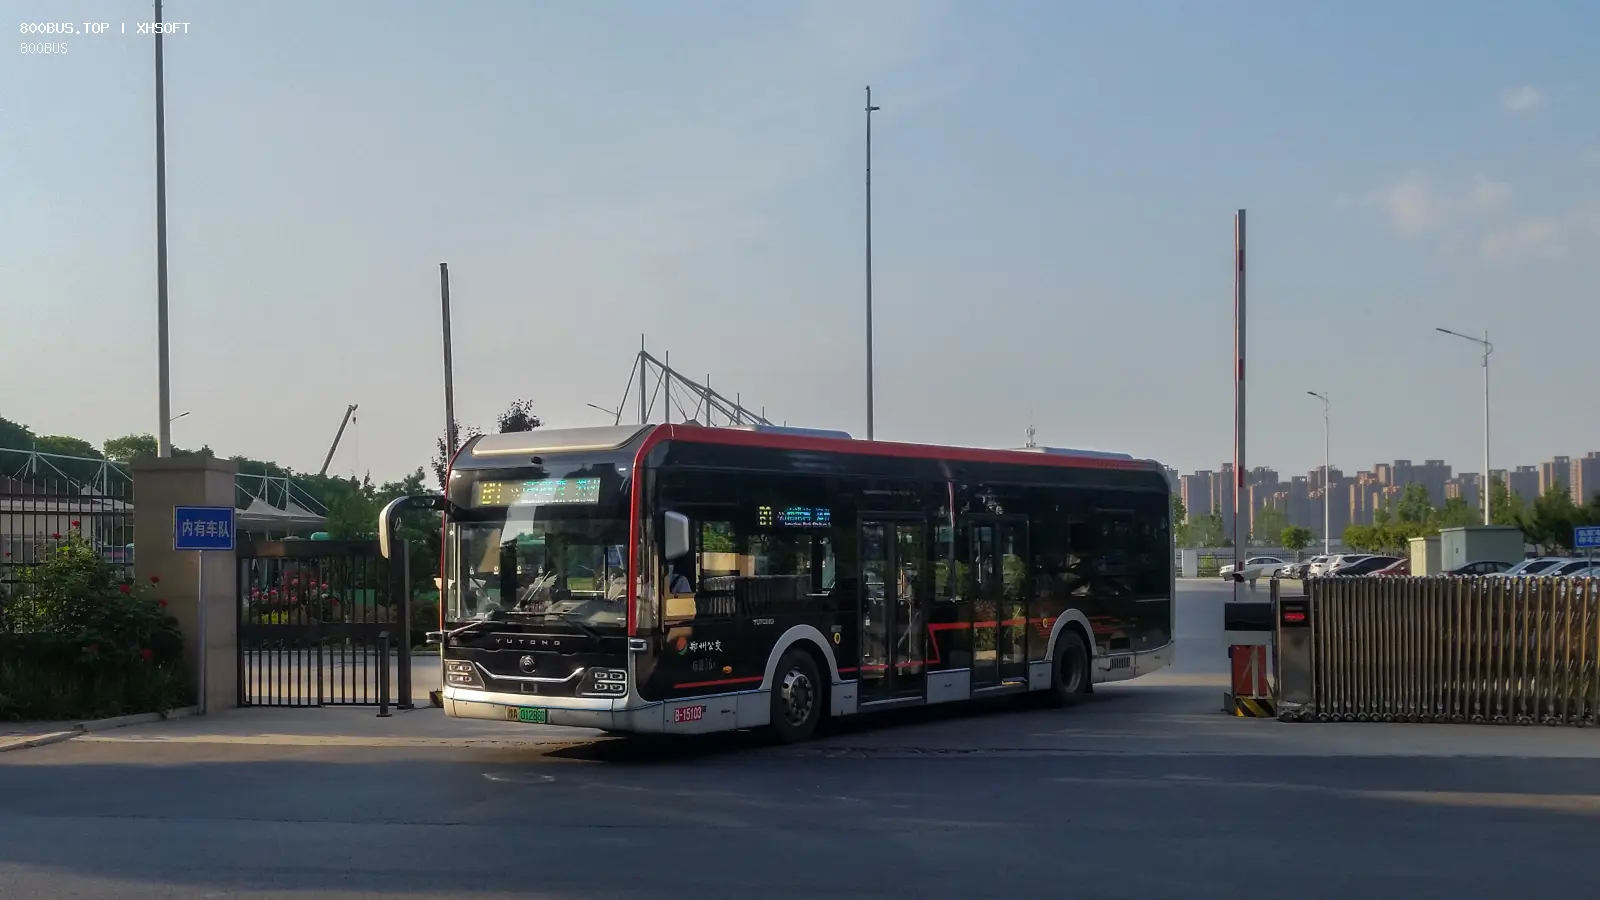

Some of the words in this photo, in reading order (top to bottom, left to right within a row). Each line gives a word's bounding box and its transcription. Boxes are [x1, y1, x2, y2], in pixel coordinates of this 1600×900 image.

[182, 519, 230, 538] 内有车队
[495, 638, 561, 646] YUTONG
[689, 639, 723, 653] 郑州公交
[674, 706, 702, 722] B-15103
